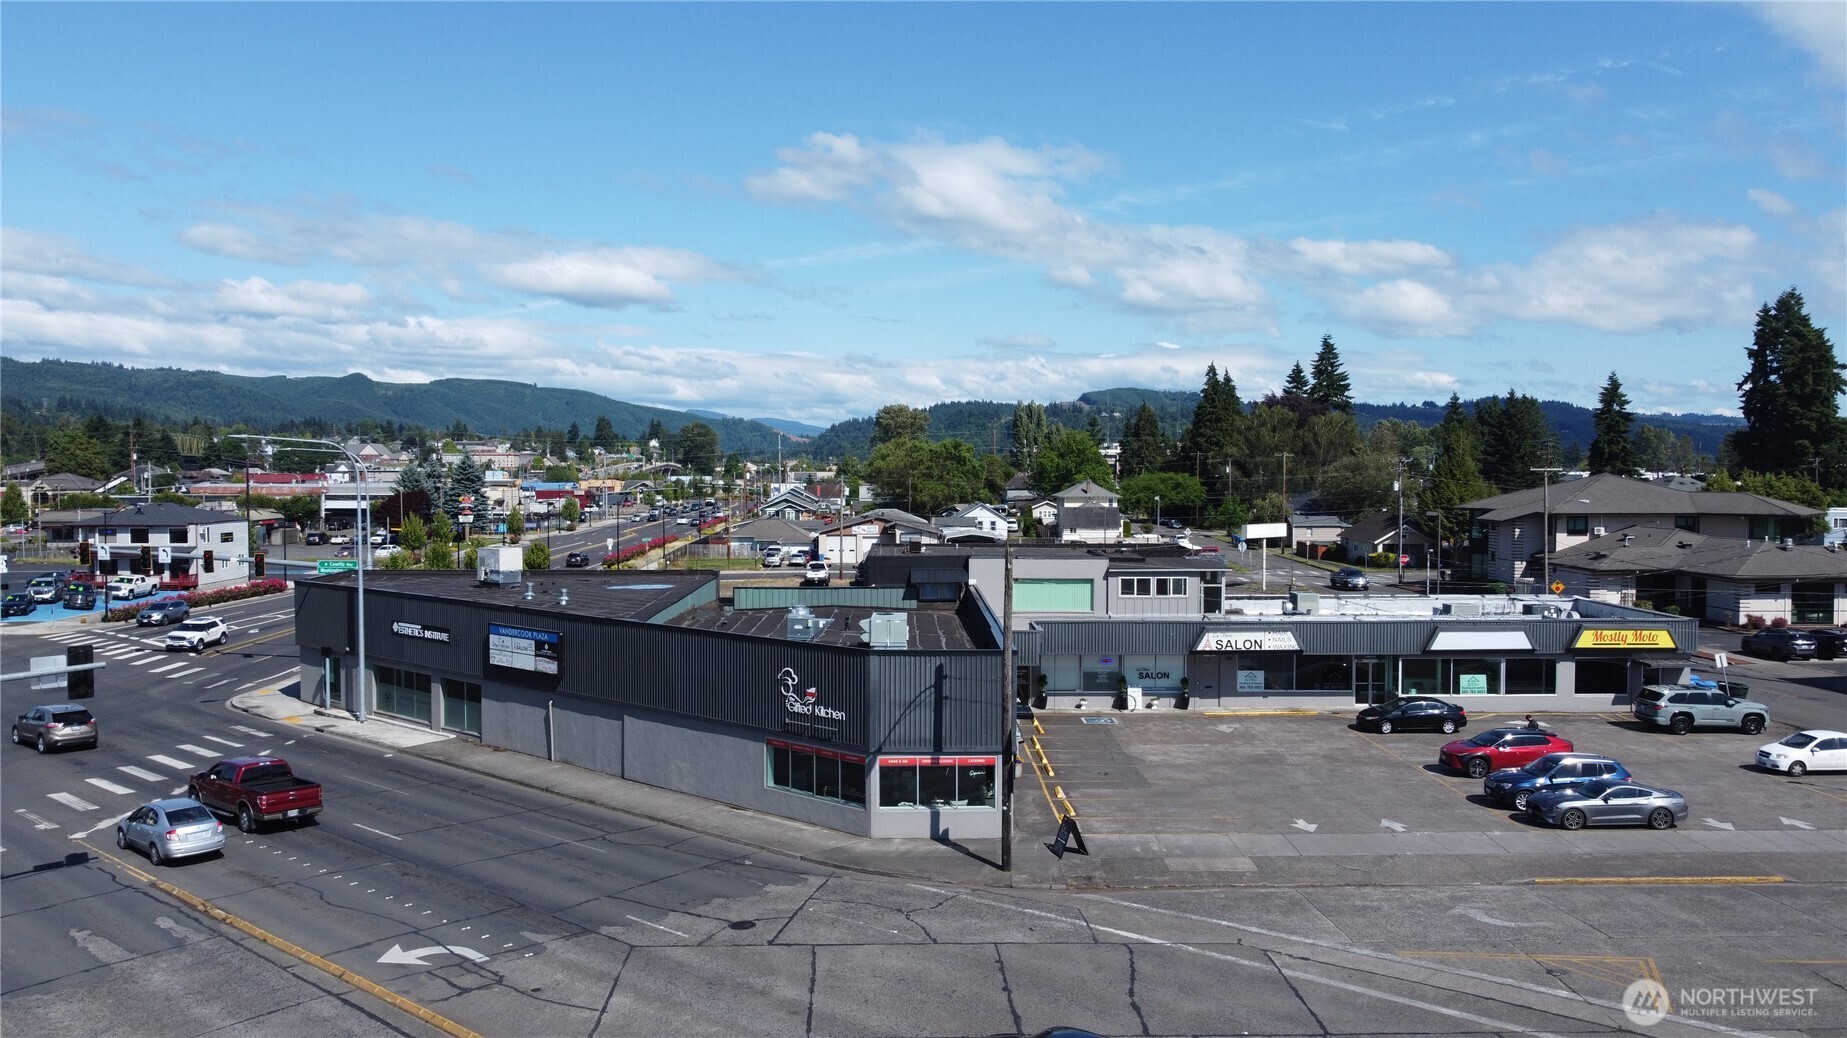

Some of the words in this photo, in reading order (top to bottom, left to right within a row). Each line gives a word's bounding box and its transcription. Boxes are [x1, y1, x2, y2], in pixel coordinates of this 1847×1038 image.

[398, 626, 424, 638] ESTHETICS
[424, 630, 450, 642] INSTITUTE
[498, 627, 533, 639] VANDERCOOK
[533, 631, 549, 641] PLAZA
[1592, 630, 1628, 645] Mostly
[1631, 630, 1659, 642] Moto
[1215, 639, 1263, 650] SALON
[1138, 672, 1170, 680] SALON
[787, 701, 812, 715] Gifted
[814, 705, 846, 721] Kitchen
